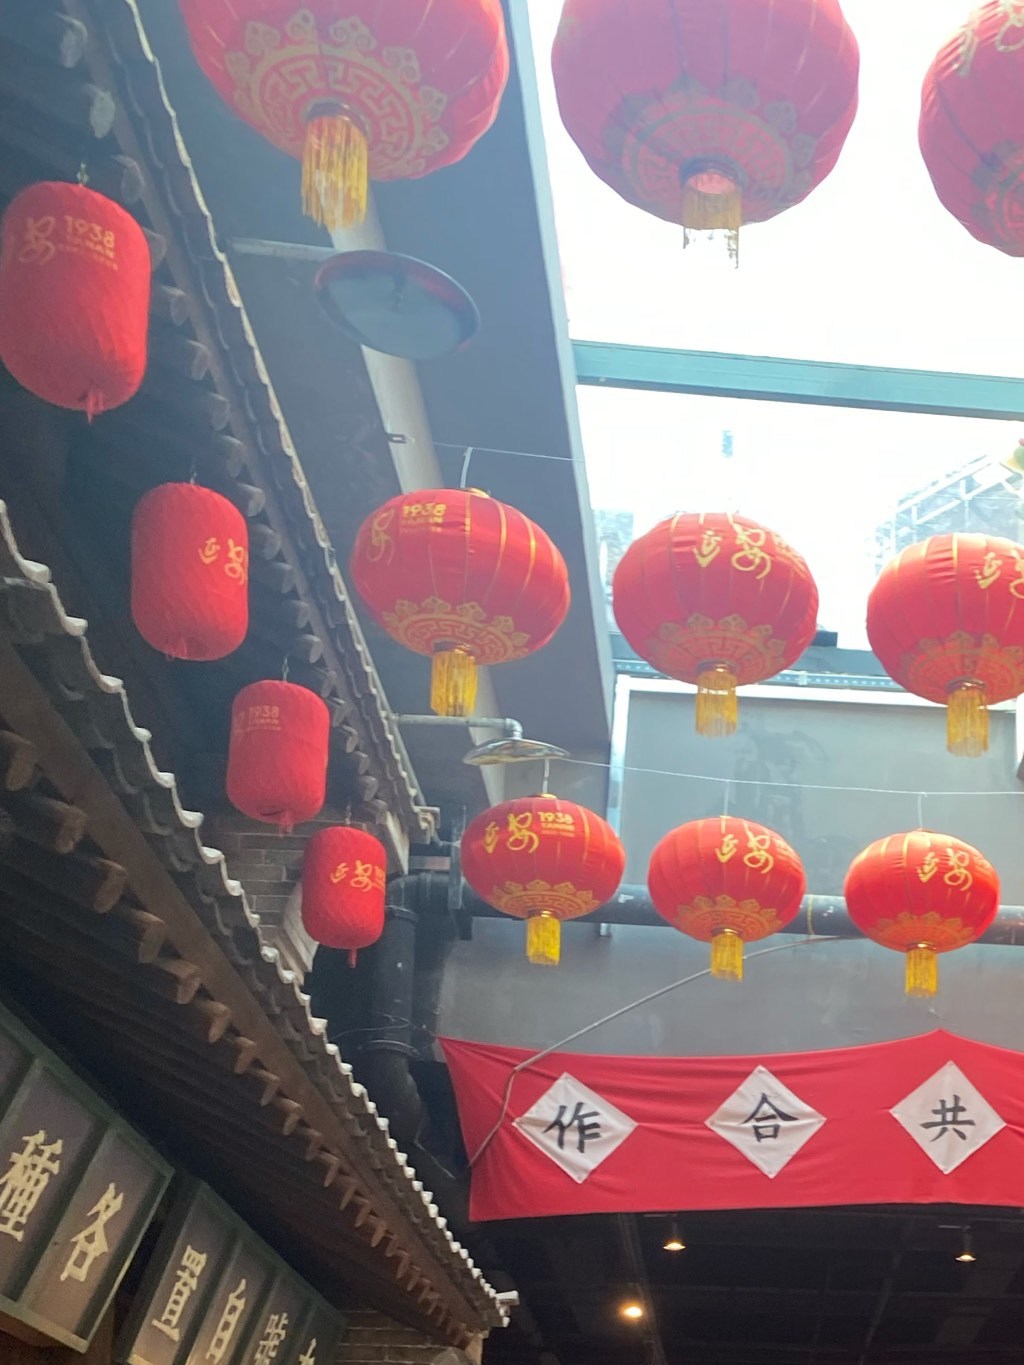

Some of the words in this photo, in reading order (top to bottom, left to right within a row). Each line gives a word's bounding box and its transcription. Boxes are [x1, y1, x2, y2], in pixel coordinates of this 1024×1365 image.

[64, 214, 115, 249] 1938
[401, 503, 446, 518] 1938
[248, 704, 280, 718] 1938
[537, 811, 574, 824] 1938
[483, 811, 540, 854] 延安
[329, 859, 373, 893] 延安
